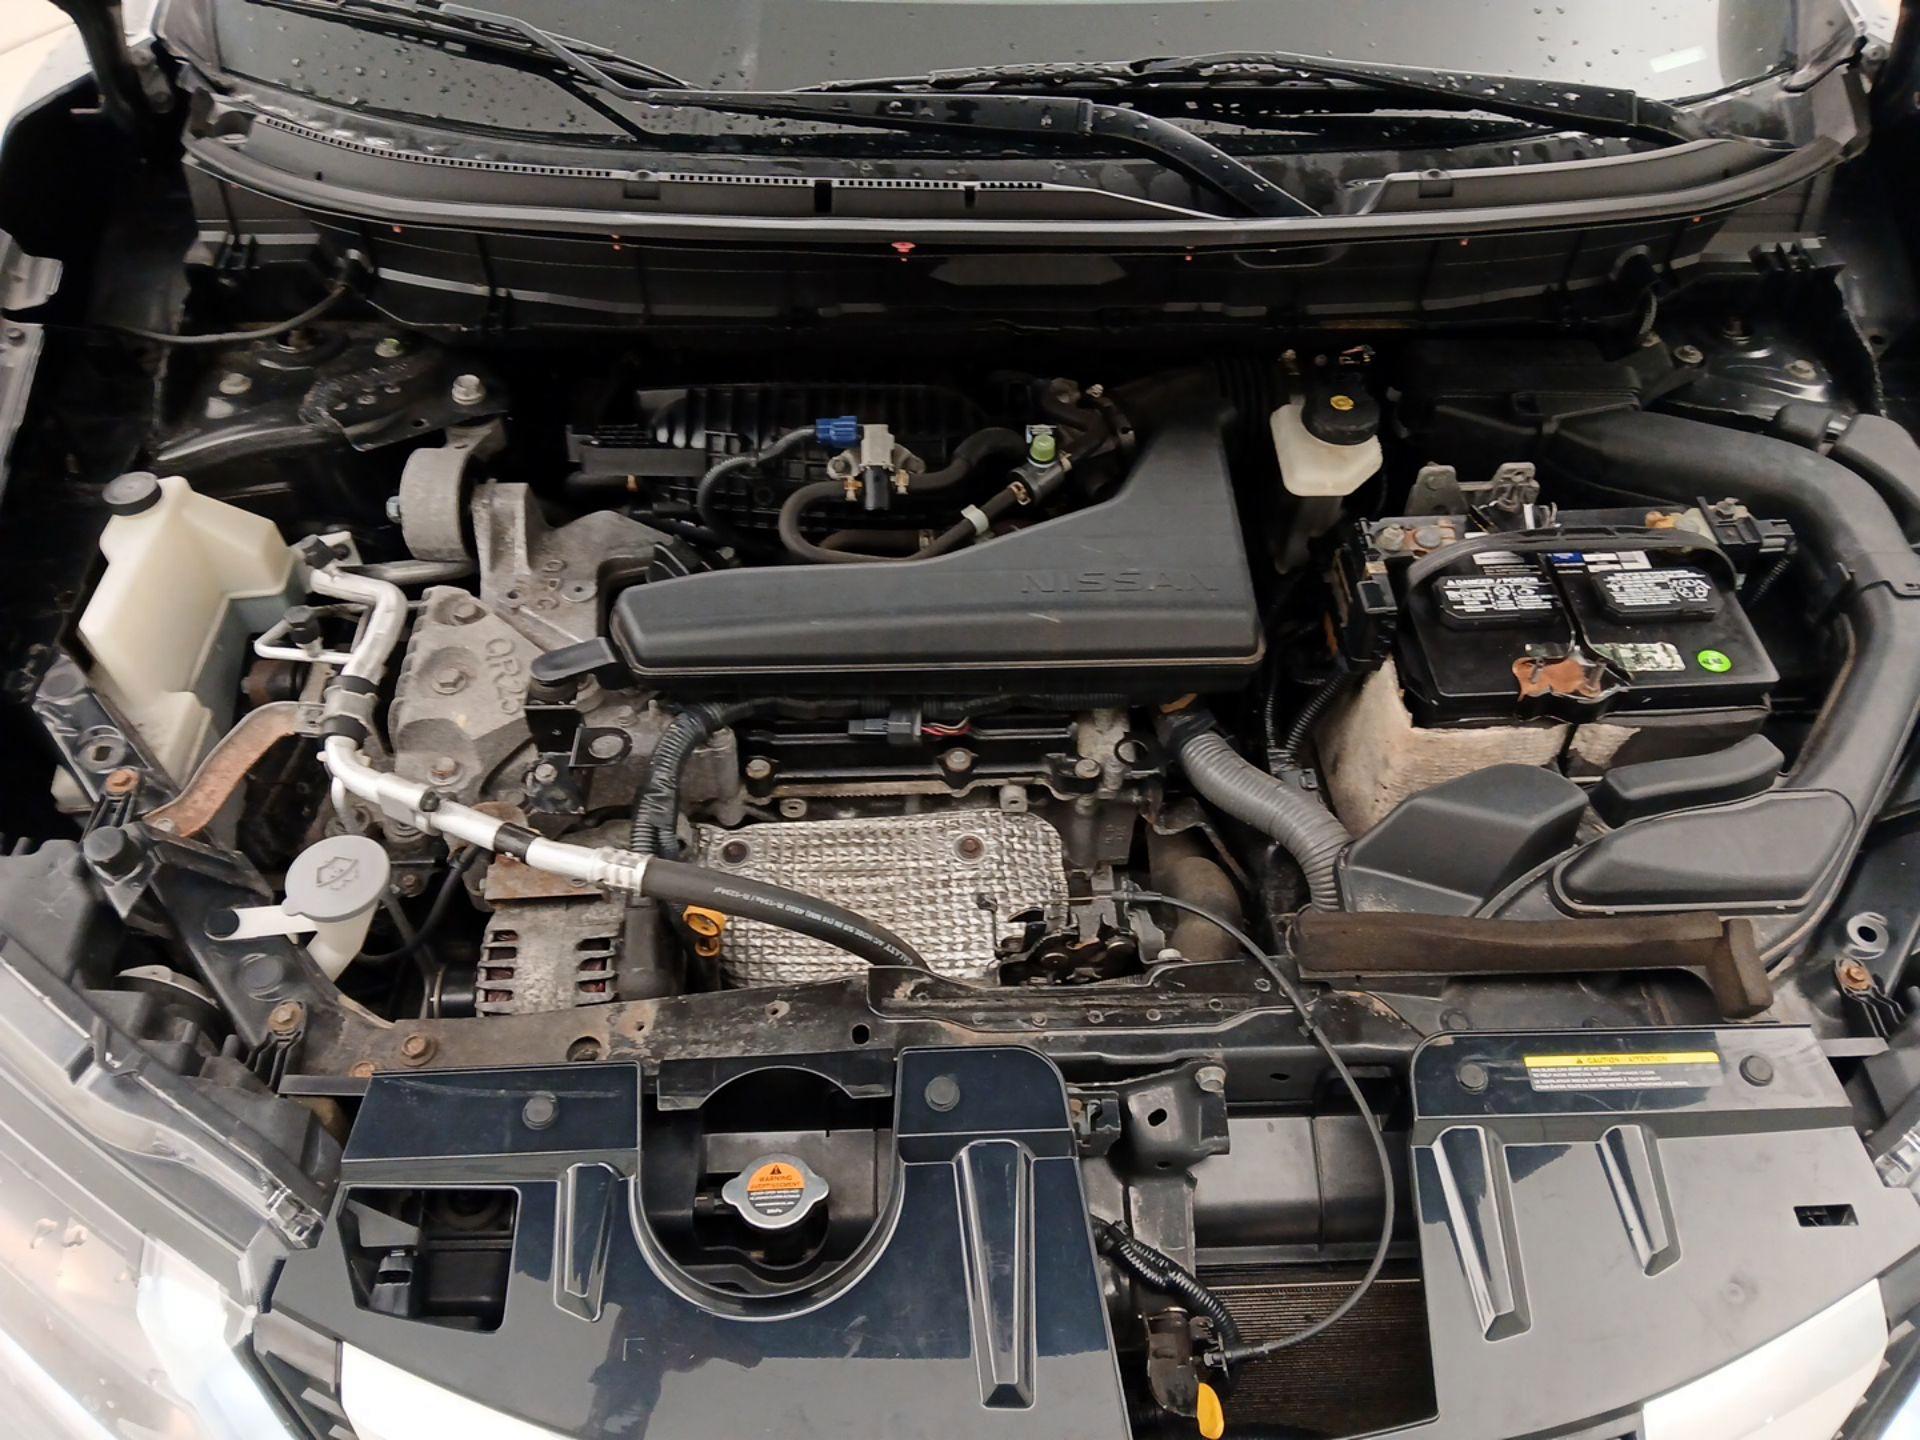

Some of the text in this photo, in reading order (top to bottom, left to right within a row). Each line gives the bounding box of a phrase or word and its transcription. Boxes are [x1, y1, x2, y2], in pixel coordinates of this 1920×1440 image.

[1020, 571, 1220, 594] NISSAN
[486, 637, 525, 714] QR25
[884, 942, 914, 966] GALAXY
